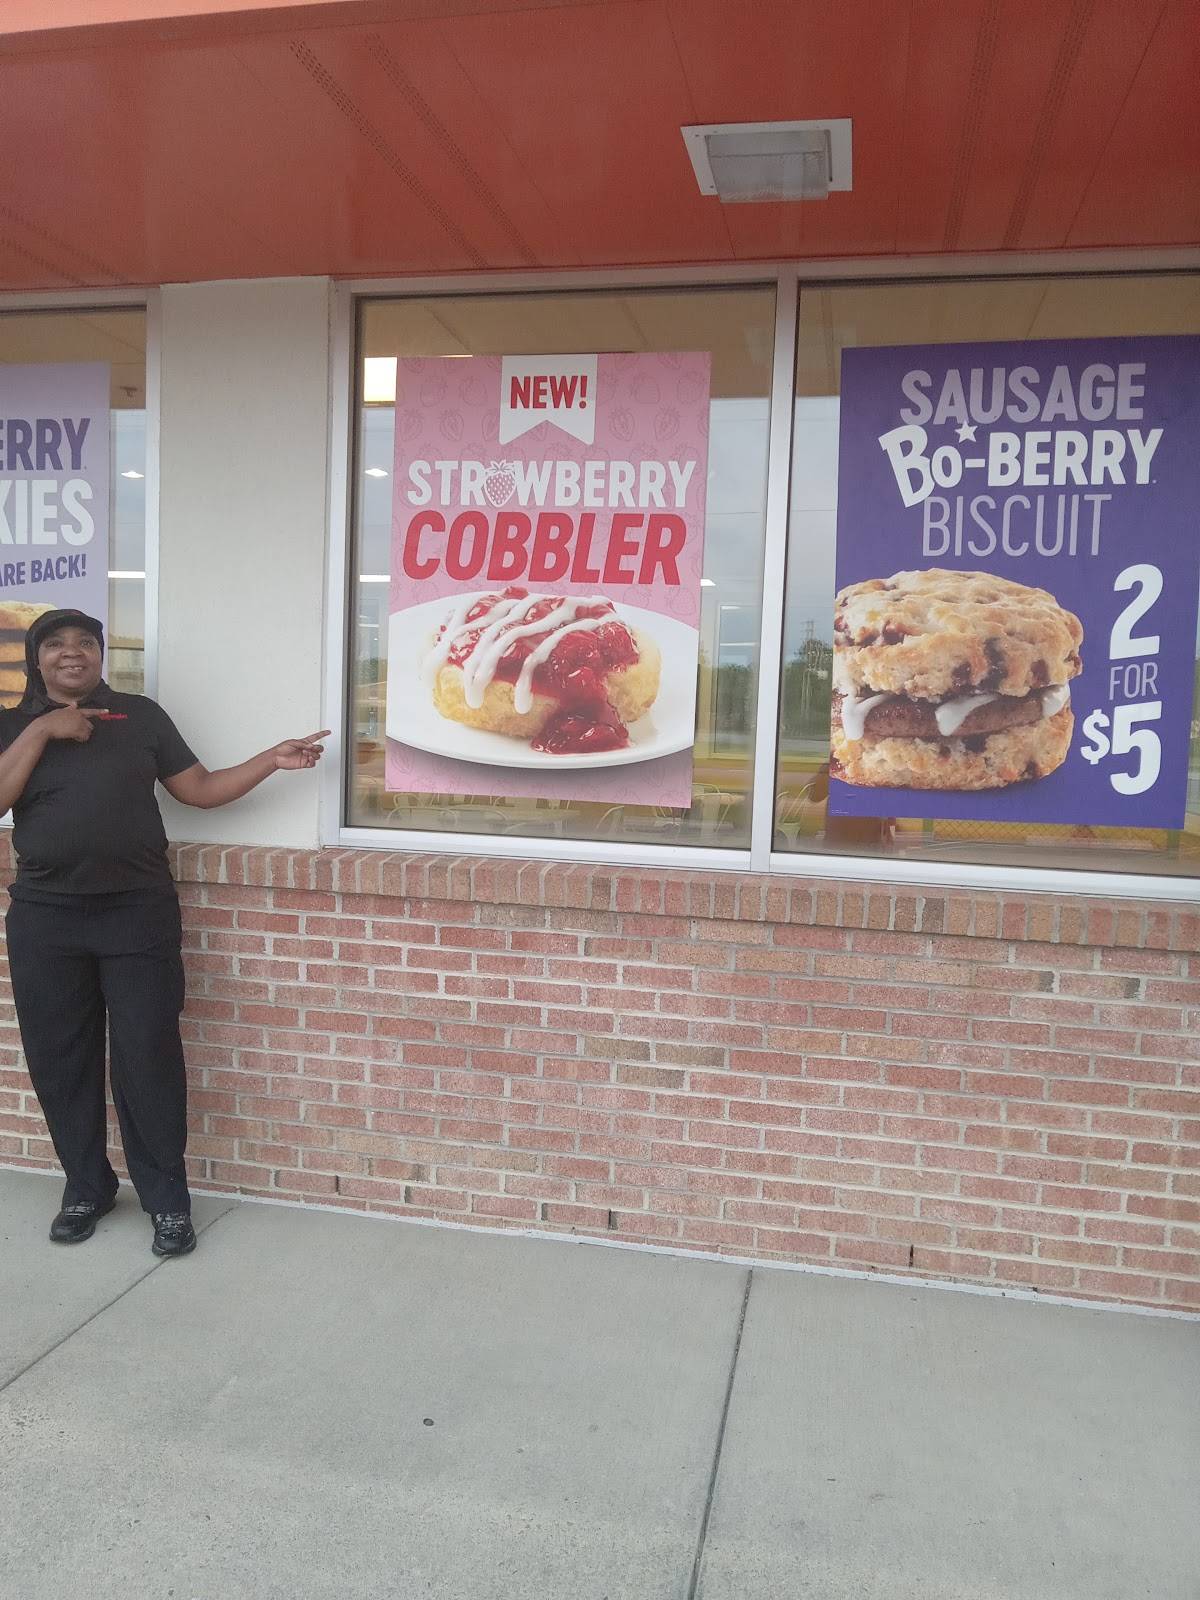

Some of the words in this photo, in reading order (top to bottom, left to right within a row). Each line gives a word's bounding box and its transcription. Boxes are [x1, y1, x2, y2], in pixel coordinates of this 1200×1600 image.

[510, 375, 588, 409] NEW!
[900, 362, 1146, 426] SAUSAGE
[0, 418, 91, 471] RRY
[407, 458, 697, 508] STRWBERRY
[402, 509, 688, 586] COBBLER
[922, 493, 1113, 556] BISCUIT
[31, 553, 87, 584] BACK!
[1109, 563, 1164, 660] 2
[1109, 662, 1159, 701] FOR
[1080, 700, 1163, 796] $5
